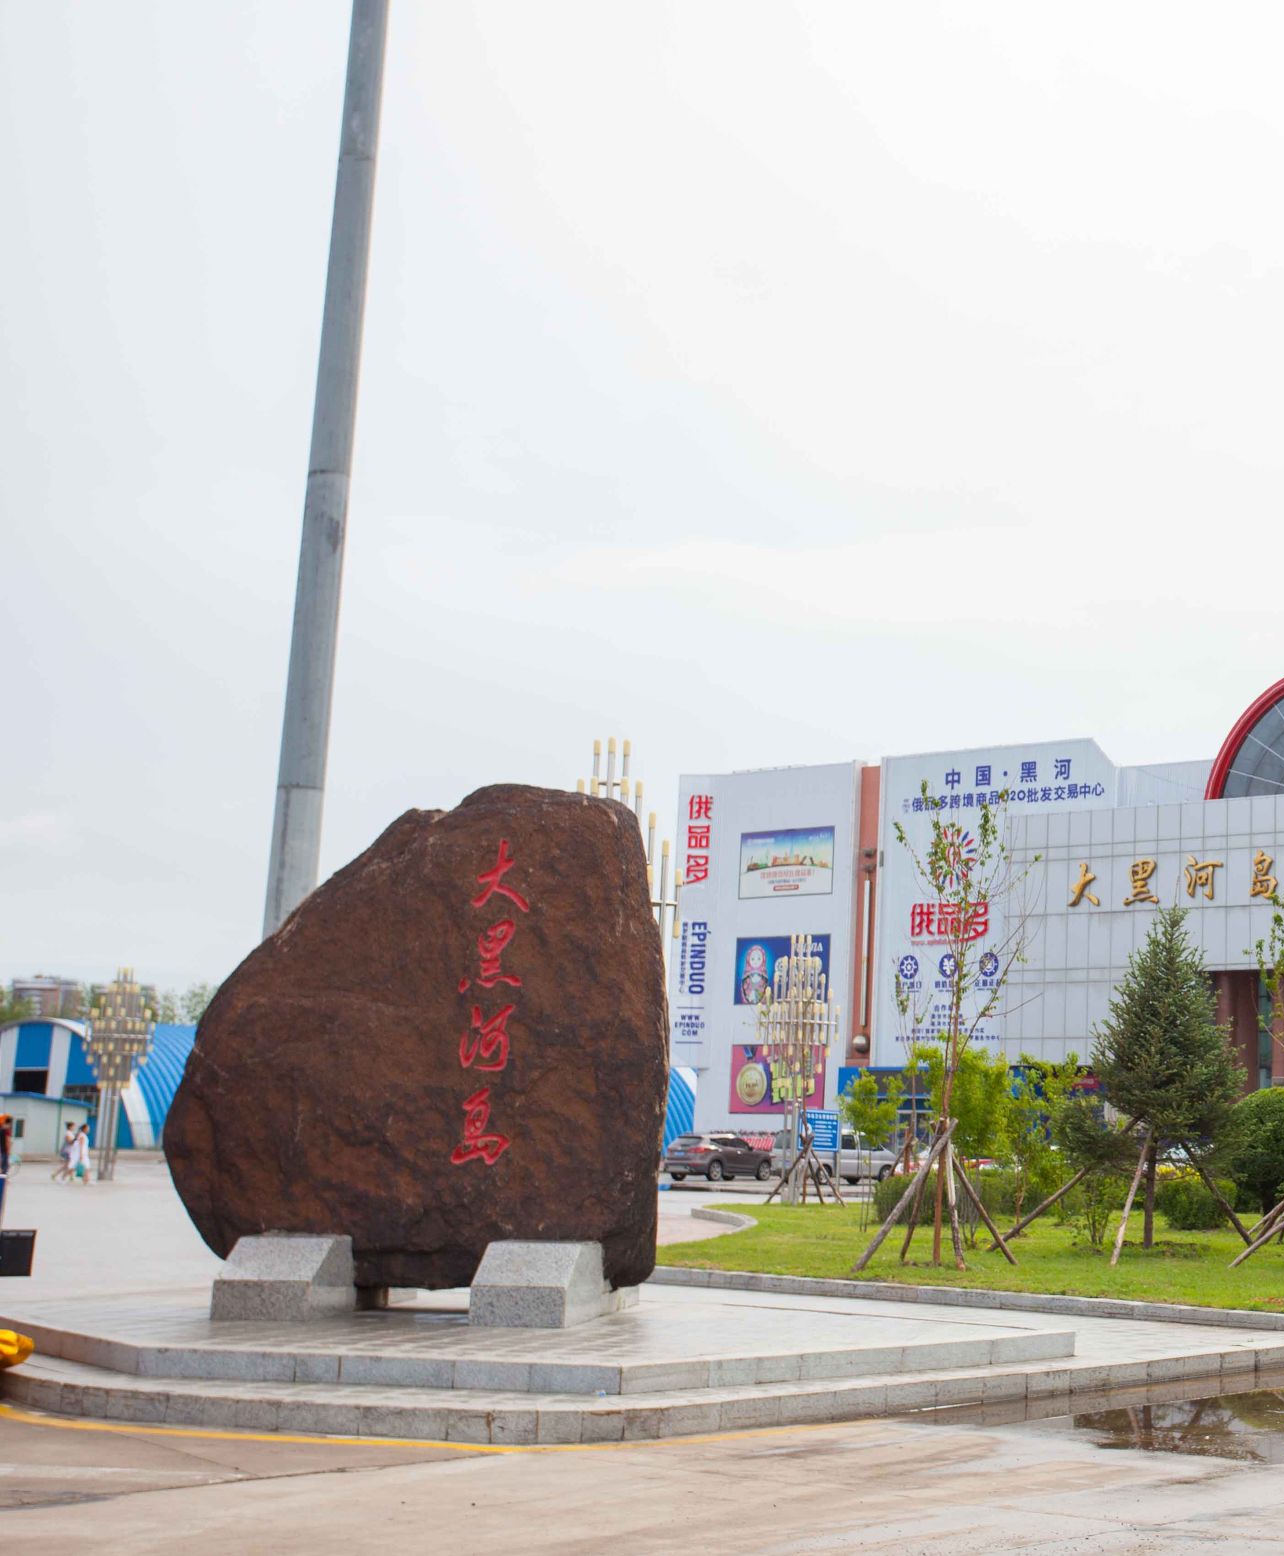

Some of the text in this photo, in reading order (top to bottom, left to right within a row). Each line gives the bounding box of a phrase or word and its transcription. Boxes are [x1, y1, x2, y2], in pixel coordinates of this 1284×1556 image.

[945, 758, 1072, 790] 中国·黑河
[682, 793, 713, 885] 俄品多
[910, 901, 989, 942] 俄品多
